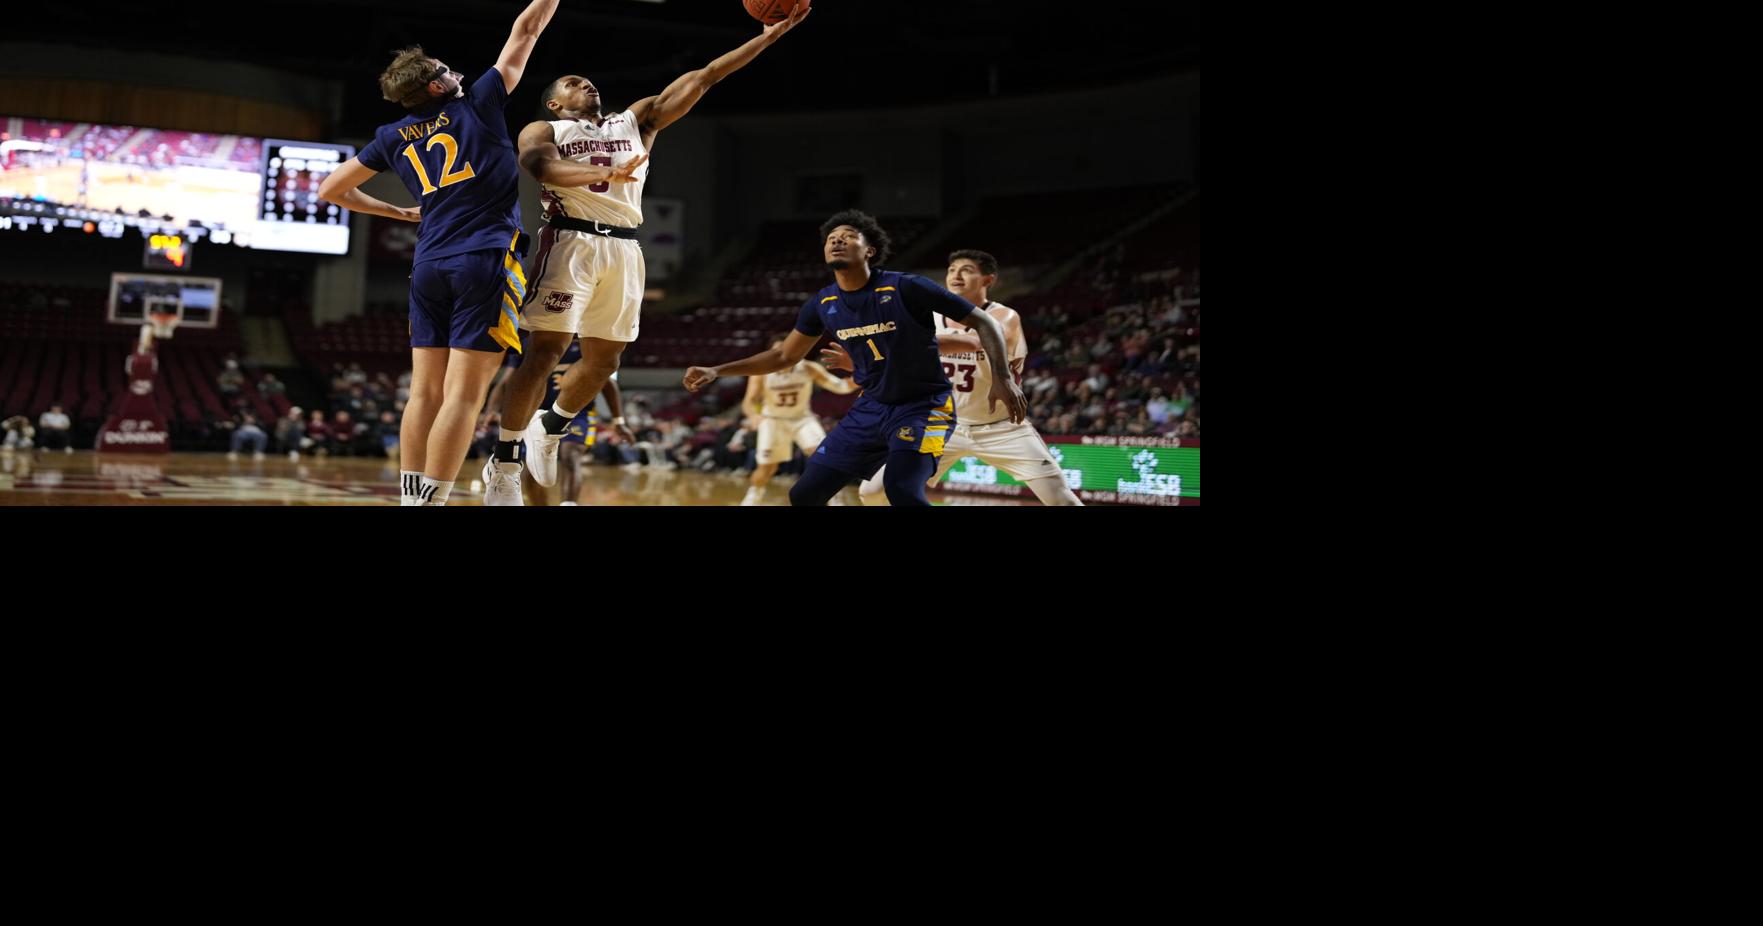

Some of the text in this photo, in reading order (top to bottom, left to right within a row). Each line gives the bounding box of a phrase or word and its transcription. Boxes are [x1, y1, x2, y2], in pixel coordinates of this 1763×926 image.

[557, 139, 633, 158] MASSACHUSETTS
[402, 132, 476, 196] 12
[866, 338, 885, 361] 1
[776, 391, 799, 408] 33
